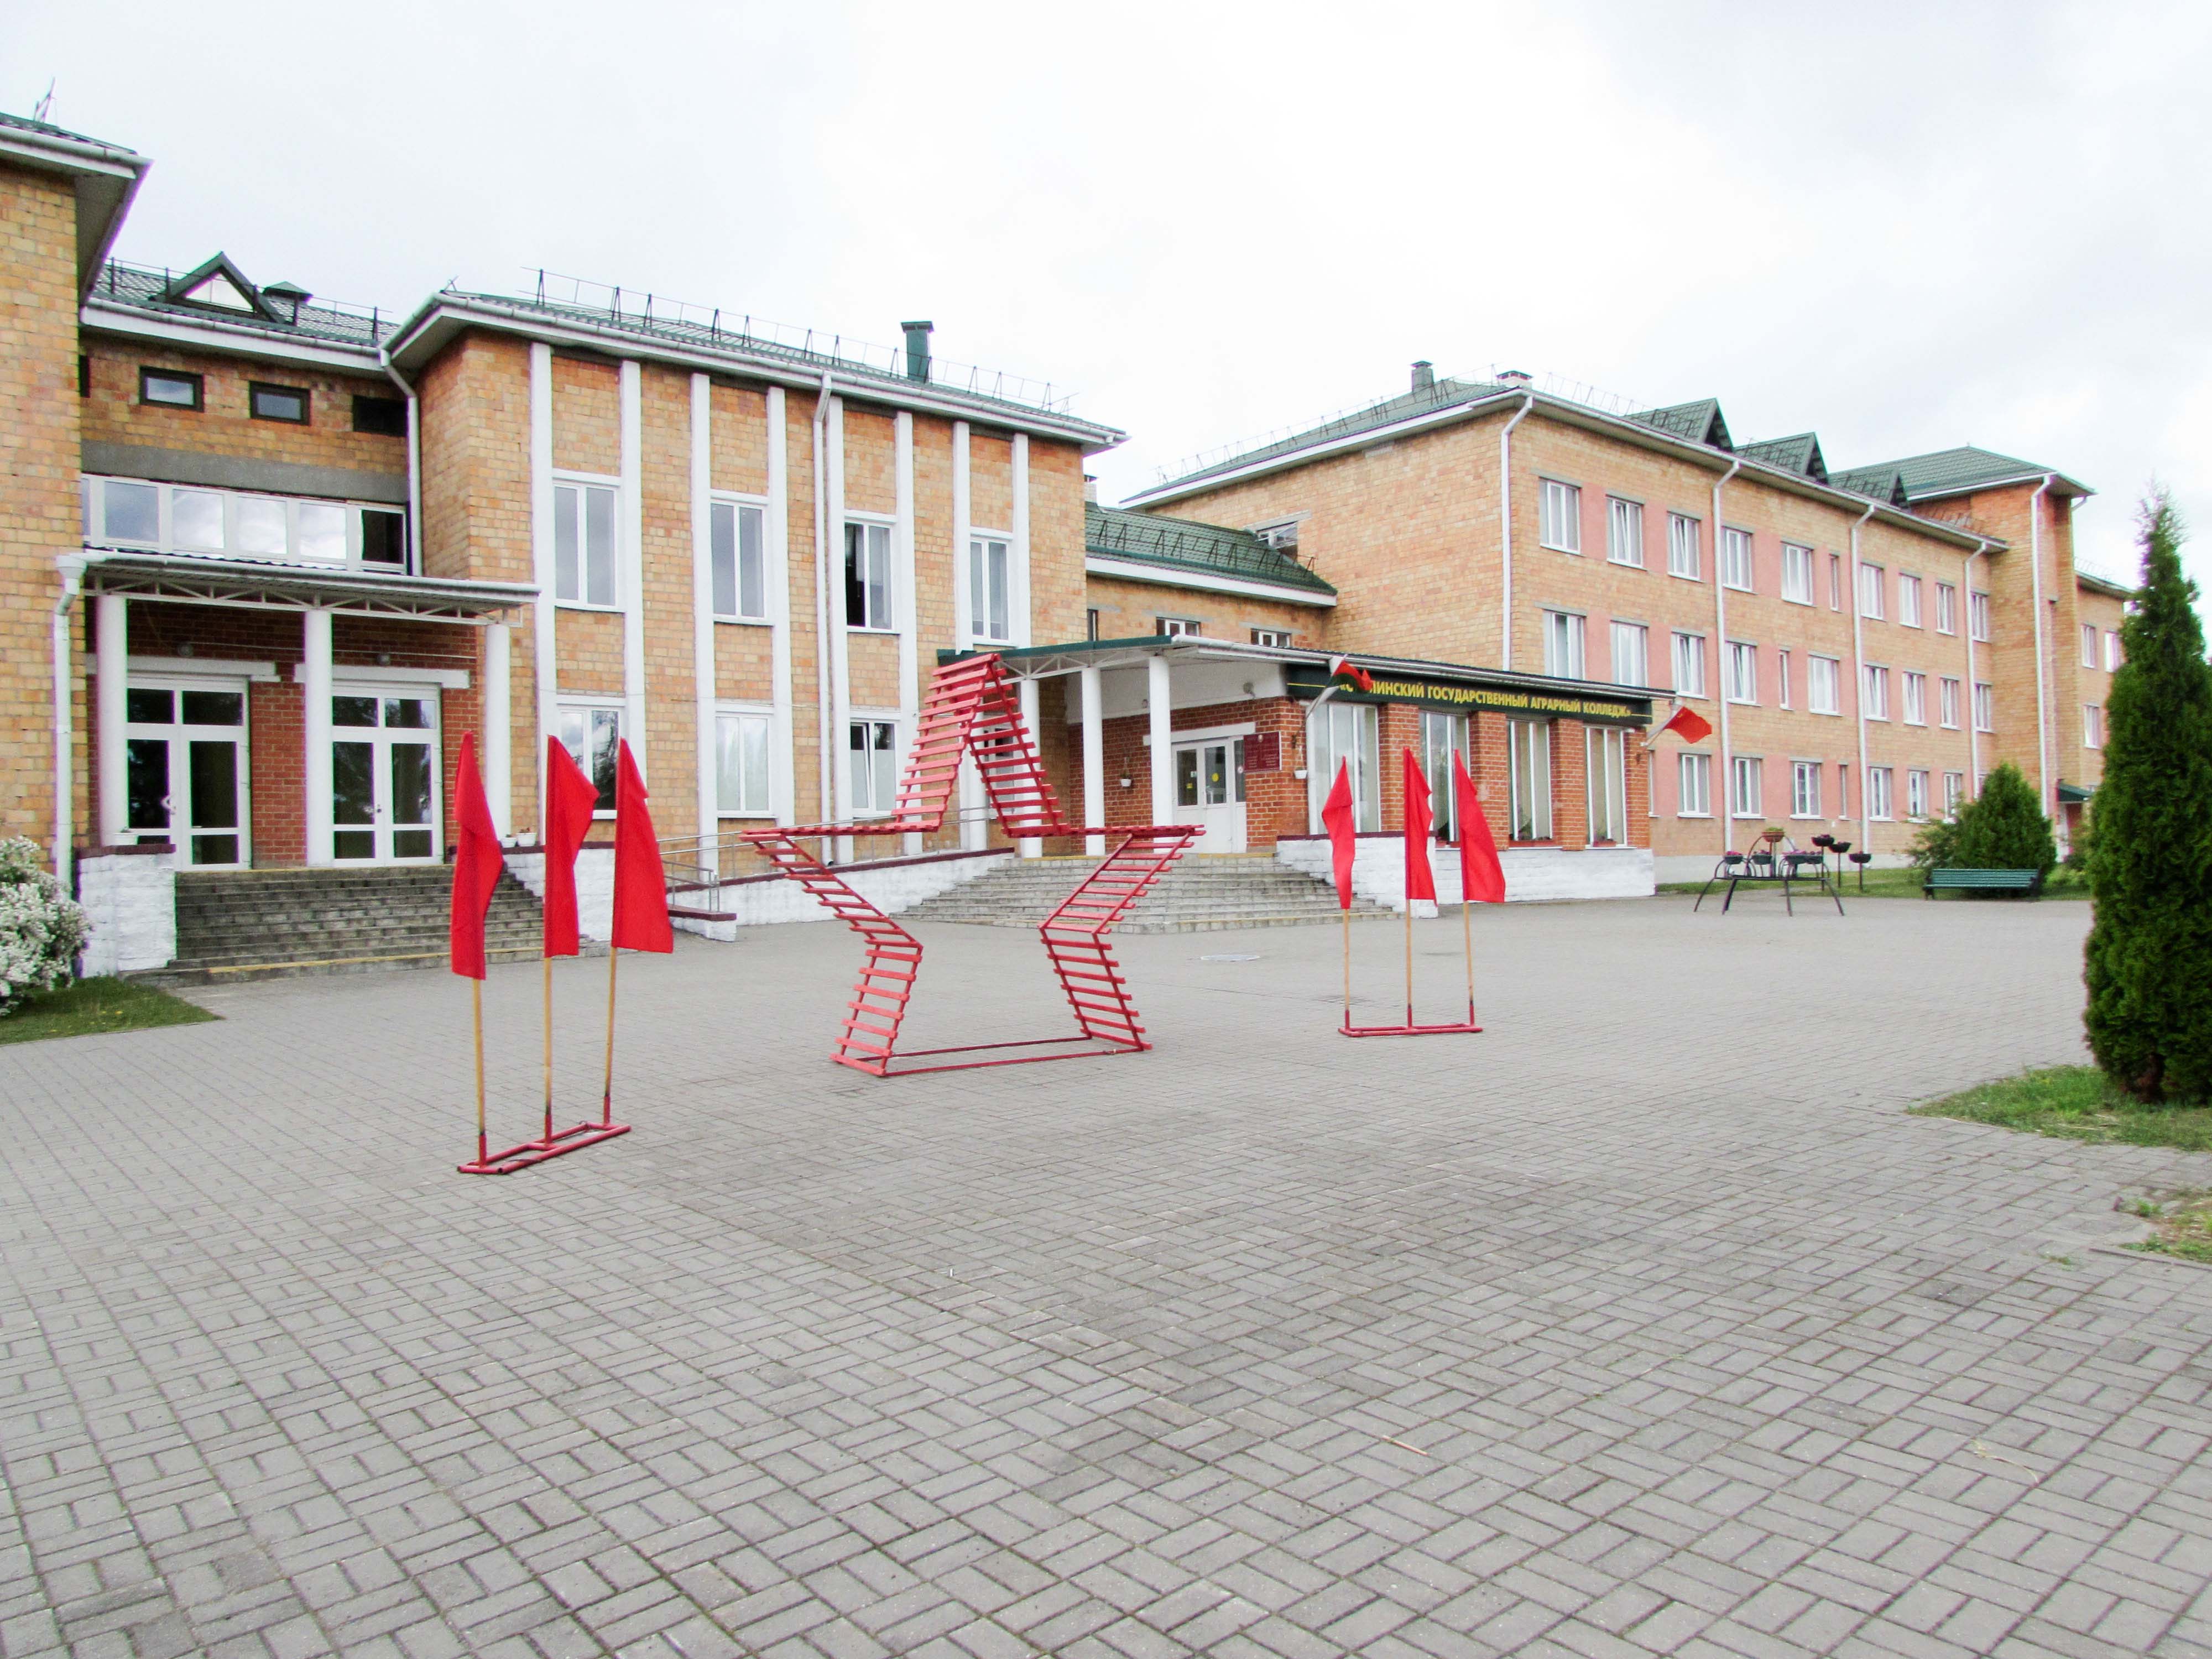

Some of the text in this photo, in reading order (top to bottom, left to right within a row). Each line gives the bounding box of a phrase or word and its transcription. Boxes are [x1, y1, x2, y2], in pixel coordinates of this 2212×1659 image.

[1339, 681, 1425, 698] «СЛИНСКИЙ
[1427, 686, 1528, 708] ГОСУДАРСТВЕННЫЙ
[1530, 697, 1581, 712] АГРАРНЫЙ
